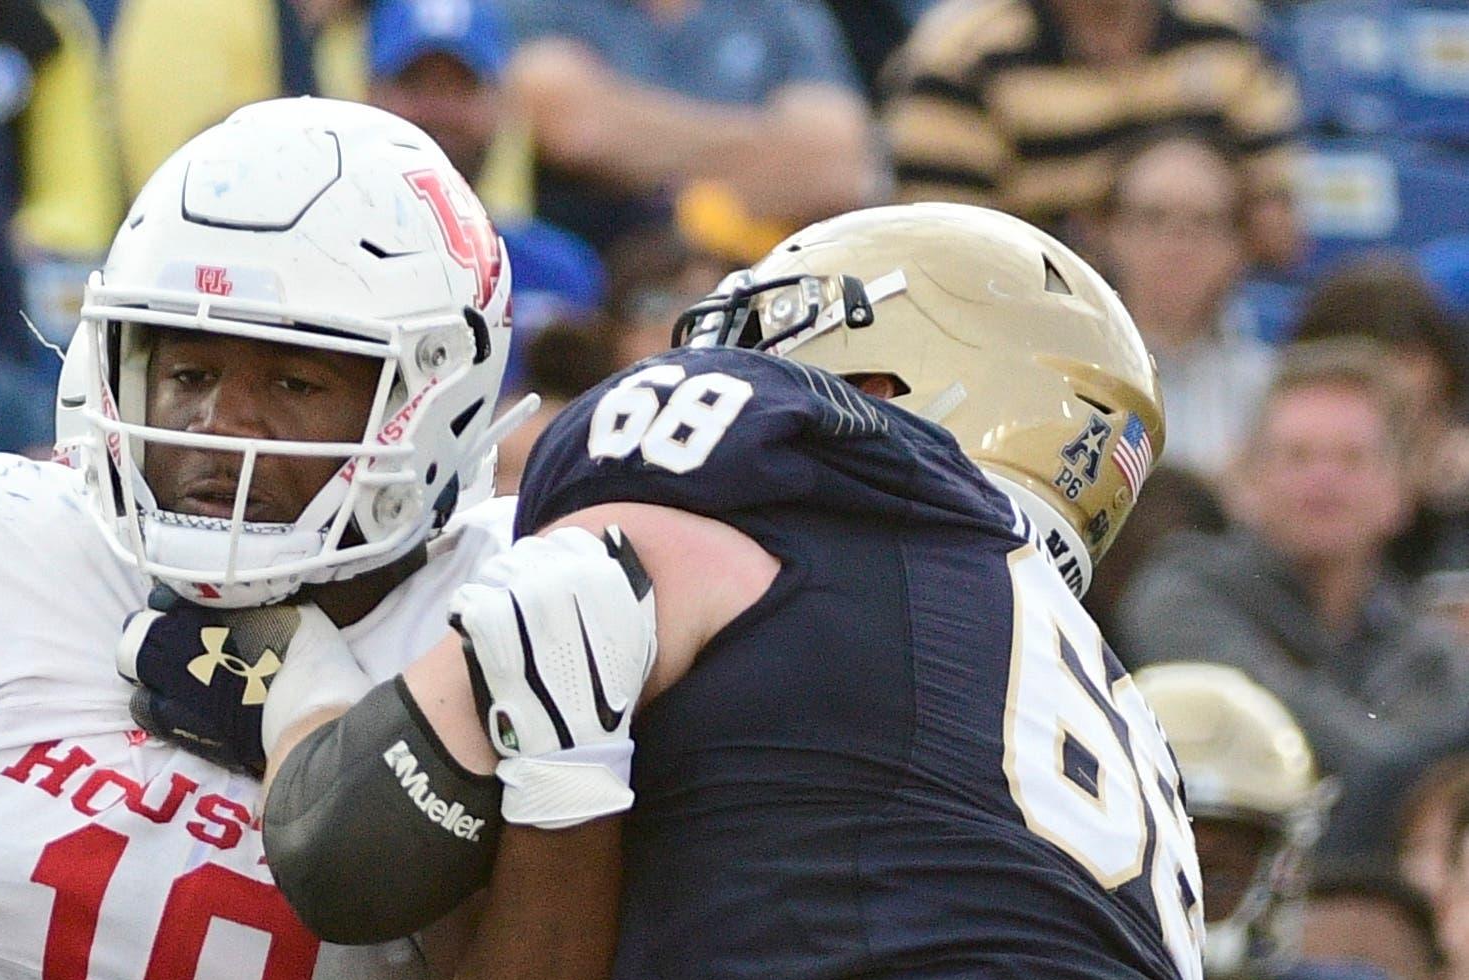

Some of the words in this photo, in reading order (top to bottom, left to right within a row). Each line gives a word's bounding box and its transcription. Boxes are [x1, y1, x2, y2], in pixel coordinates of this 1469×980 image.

[587, 364, 754, 475] 68
[0, 738, 268, 866] HOUS
[393, 751, 486, 841] Mueller
